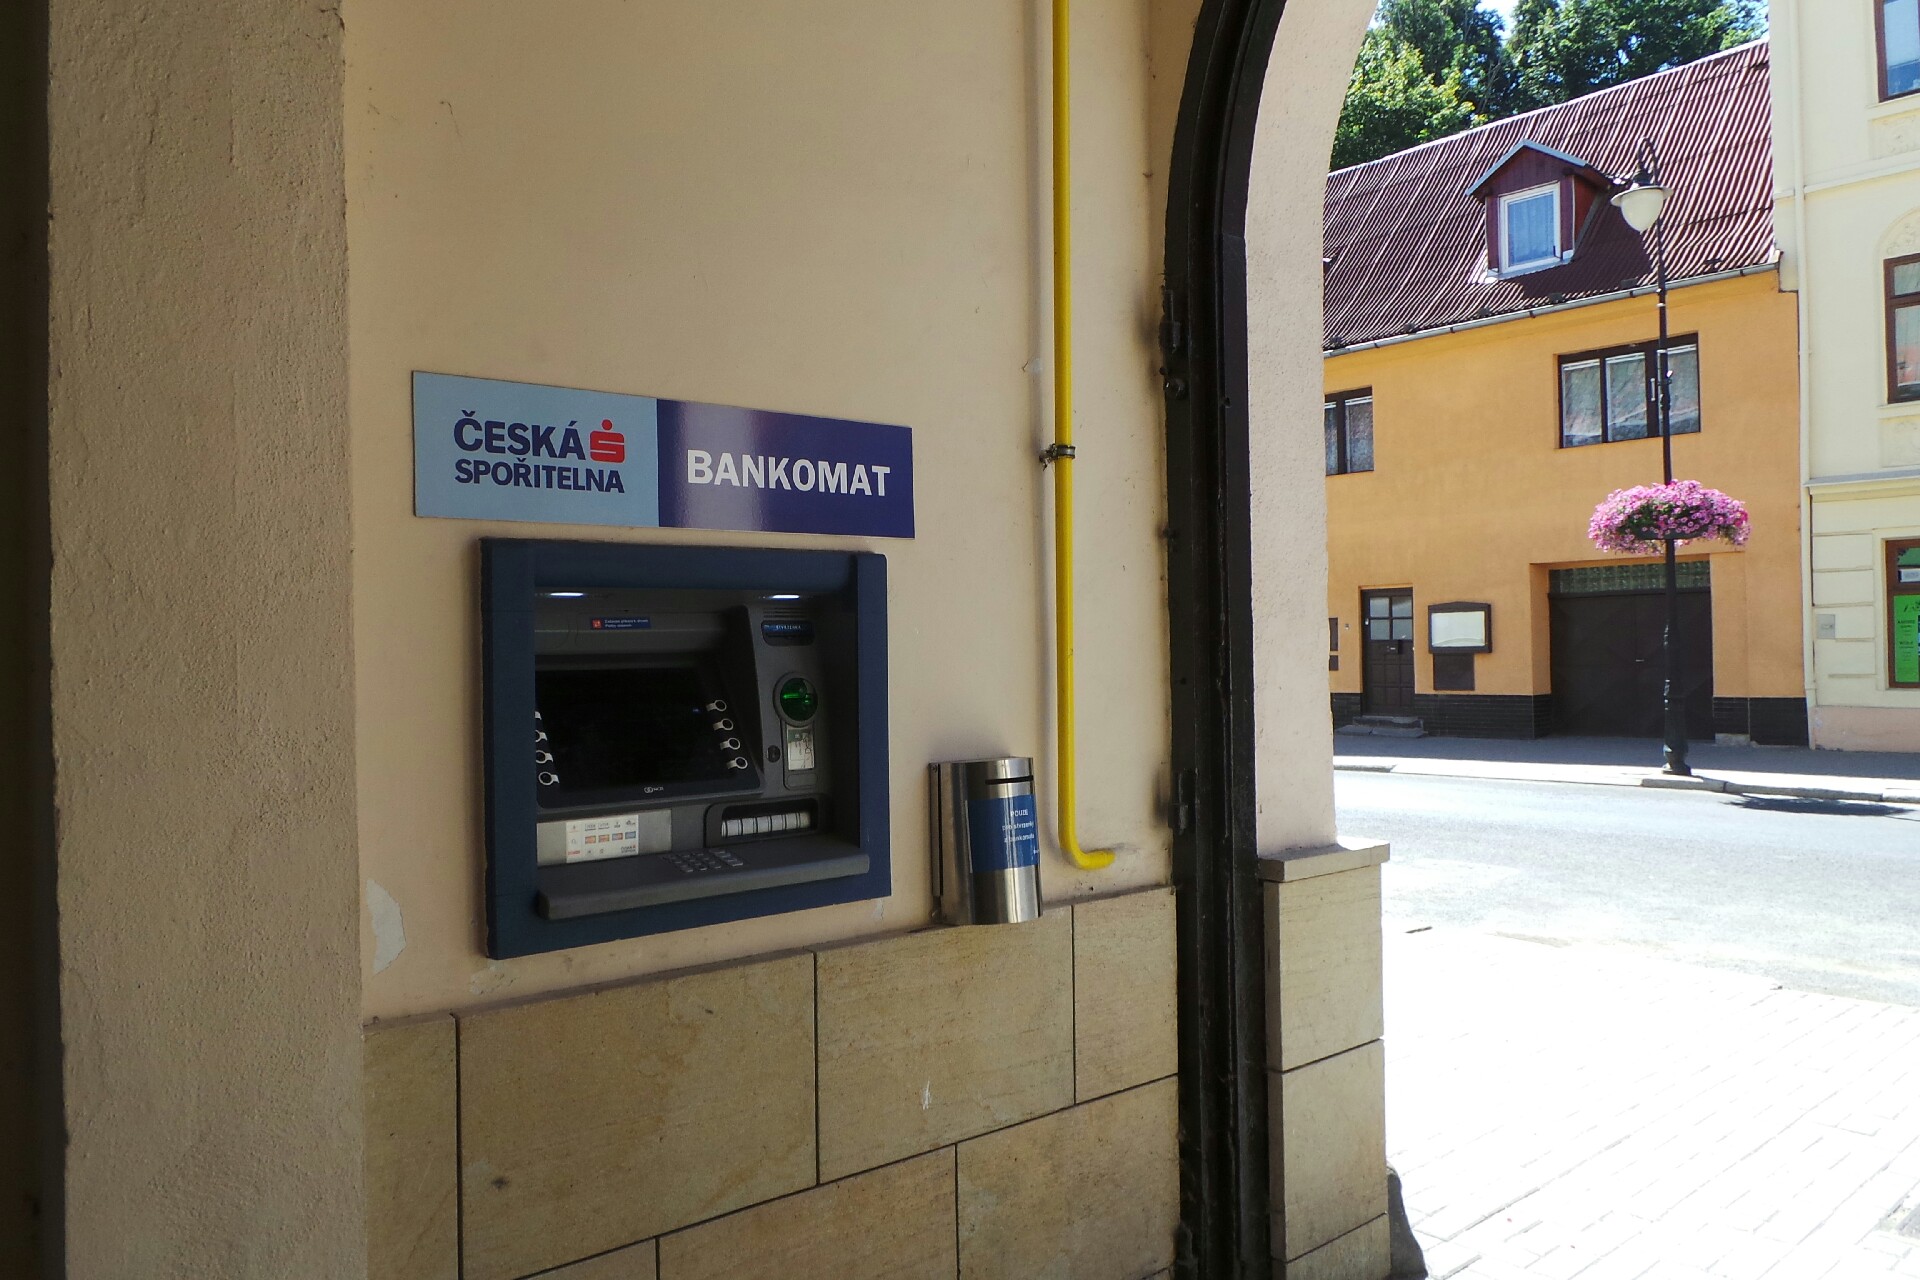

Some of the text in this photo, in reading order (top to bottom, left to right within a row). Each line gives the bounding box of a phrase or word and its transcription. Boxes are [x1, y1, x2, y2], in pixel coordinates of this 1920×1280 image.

[453, 409, 586, 461] ČESKÁ
[454, 457, 625, 494] SPOŘITELNA
[687, 449, 891, 497] BANKOMAT
